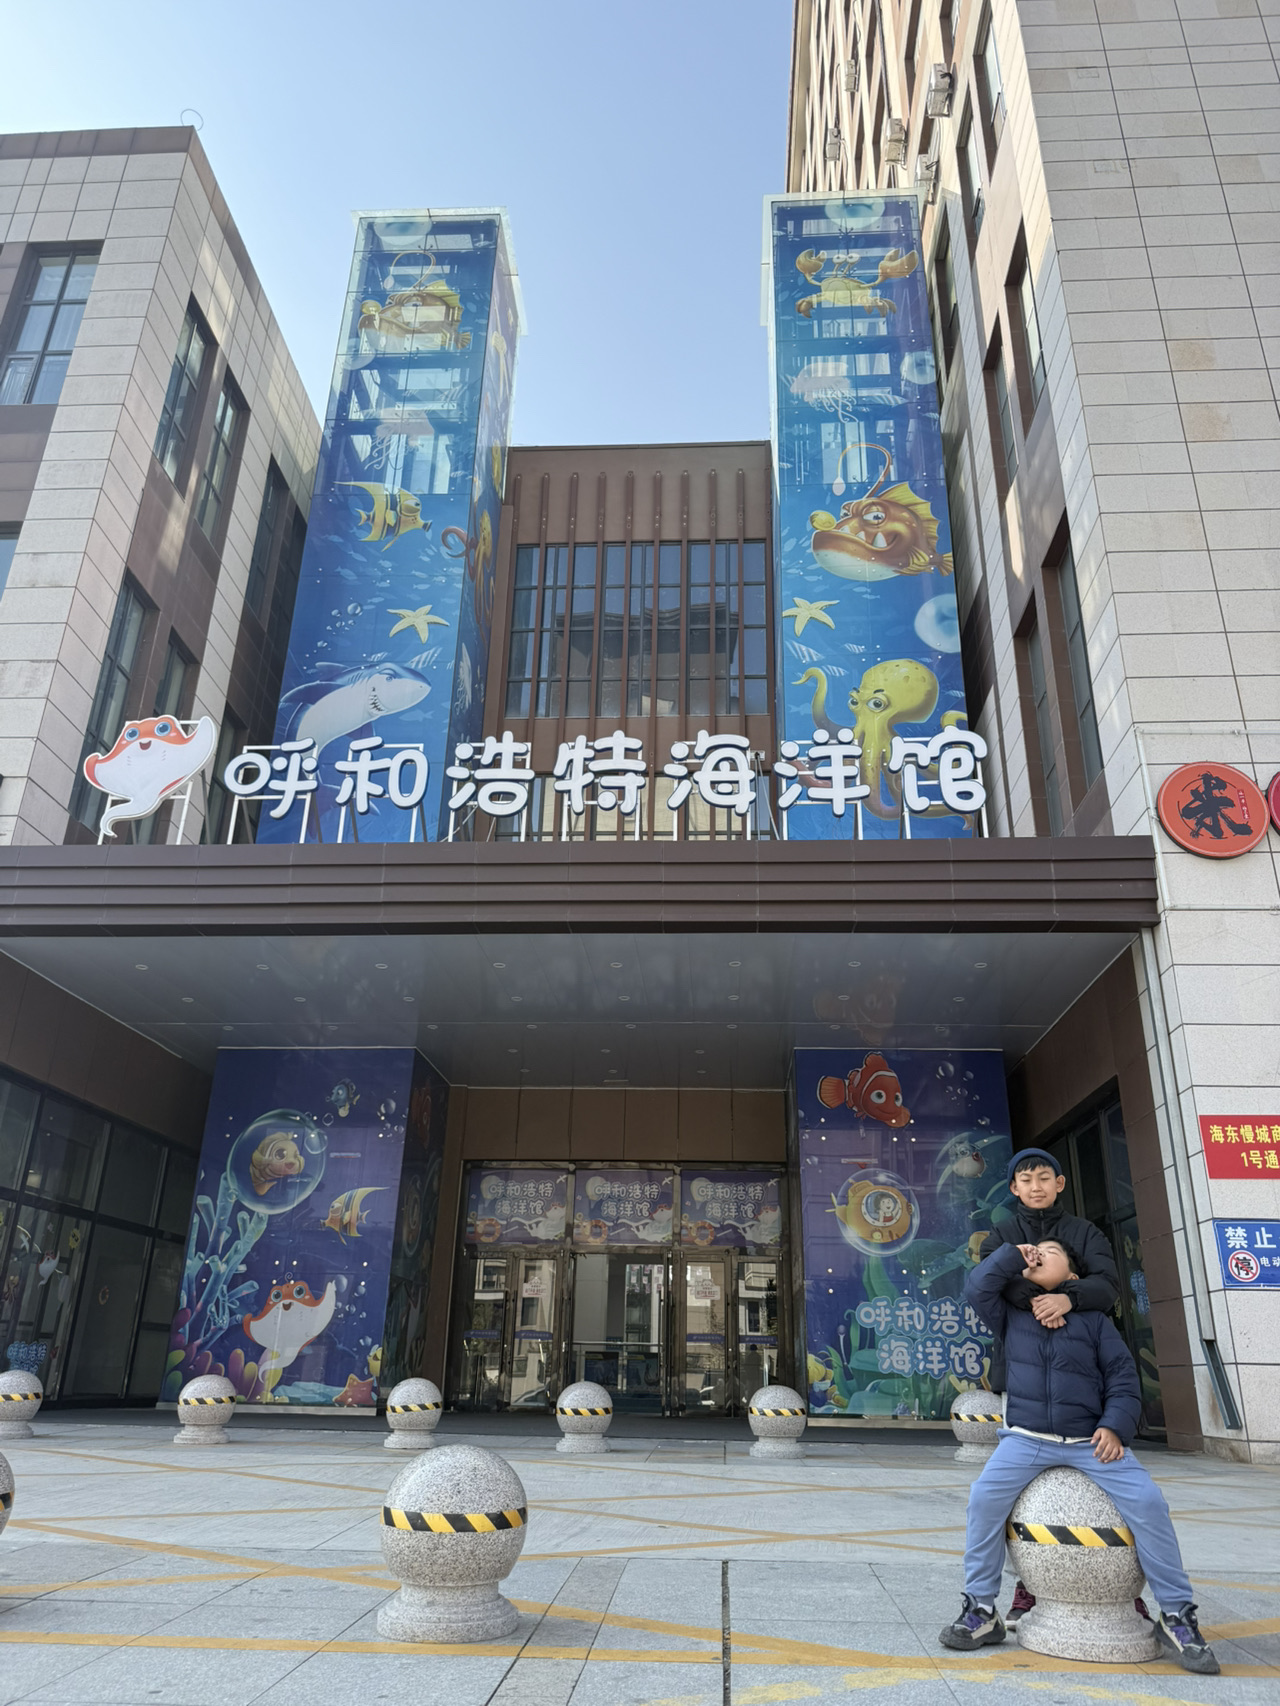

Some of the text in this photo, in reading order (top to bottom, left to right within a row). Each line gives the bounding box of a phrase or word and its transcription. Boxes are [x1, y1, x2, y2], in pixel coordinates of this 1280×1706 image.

[224, 726, 988, 819] 呼和浩特海洋馆
[1210, 1124, 1280, 1144] 海东慢城商
[1240, 1150, 1280, 1169] 1号通
[490, 1182, 554, 1198] 呼和浩特
[595, 1182, 661, 1199] 呼和浩特
[699, 1184, 763, 1201] 呼和浩特
[496, 1201, 545, 1216] 海洋馆
[602, 1201, 651, 1217] 海洋馆
[707, 1202, 756, 1218] 海洋馆
[1225, 1226, 1277, 1249] 禁止
[880, 1340, 981, 1375] 海洋馆
